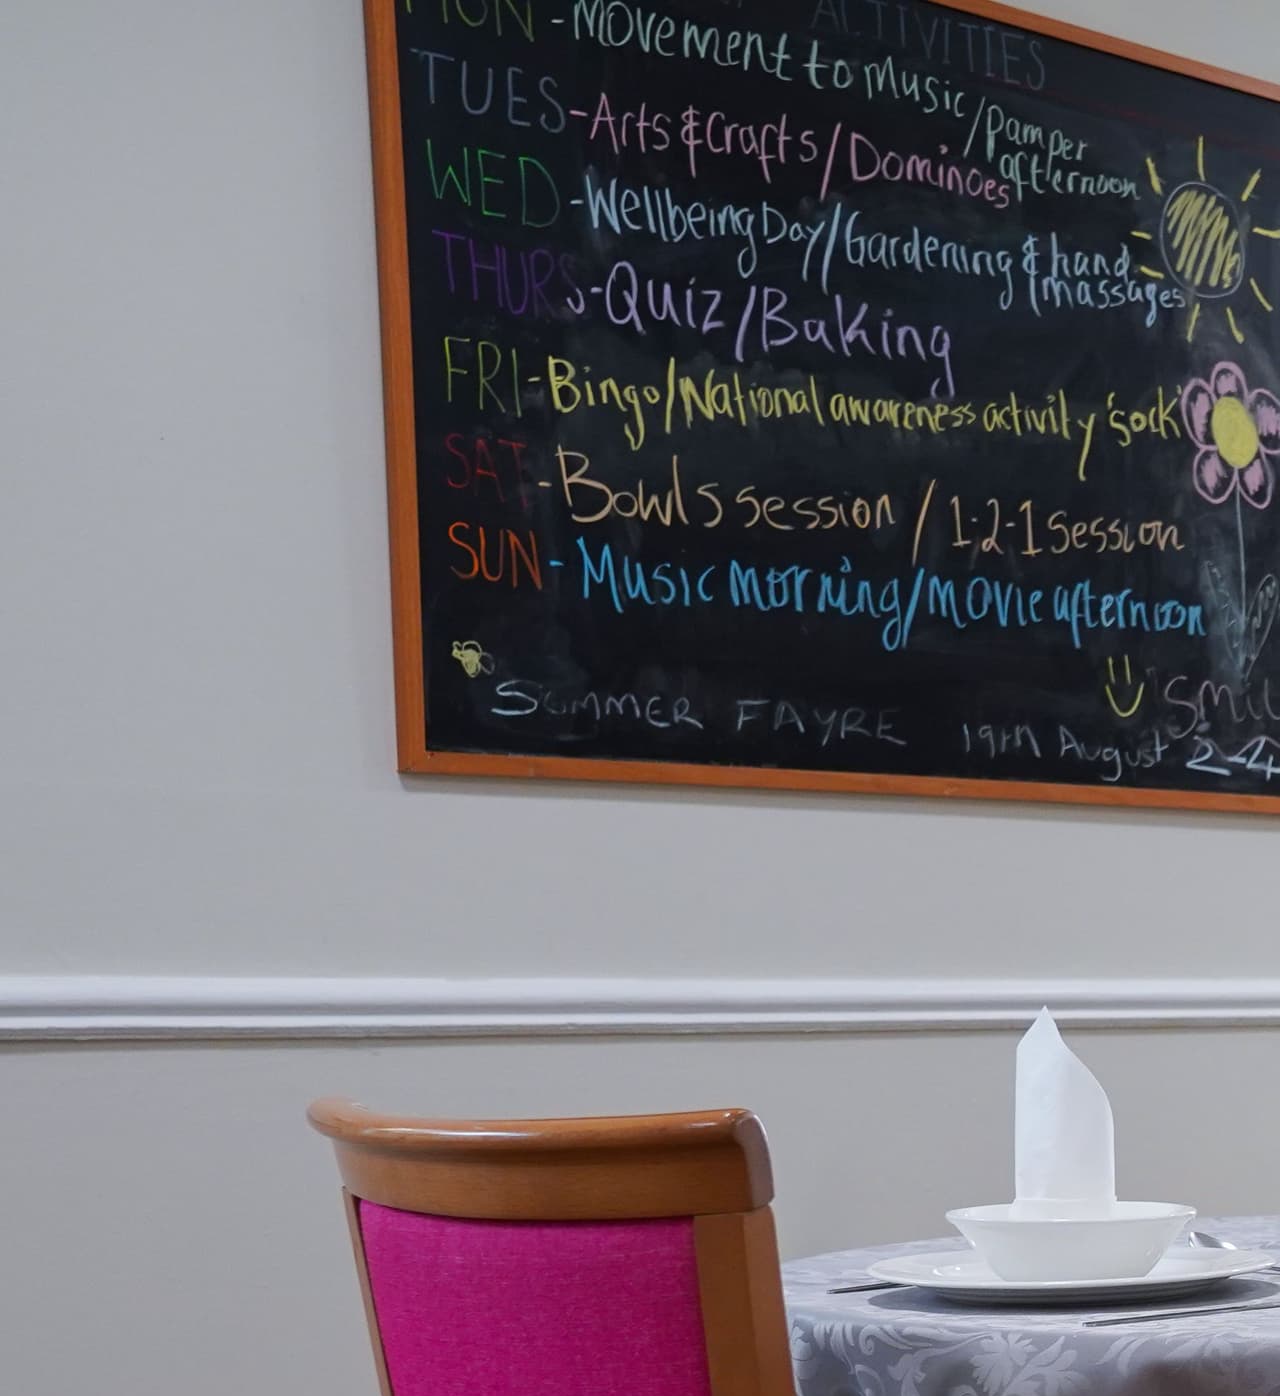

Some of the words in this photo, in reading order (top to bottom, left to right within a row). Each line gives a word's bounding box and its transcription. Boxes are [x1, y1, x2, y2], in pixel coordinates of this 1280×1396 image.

[803, 40, 853, 89] to
[1000, 151, 1141, 202] afternoon
[1051, 232, 1130, 284] hand
[829, 392, 977, 434] awareness
[983, 388, 1096, 482] activity
[1052, 578, 1207, 649] afternoon
